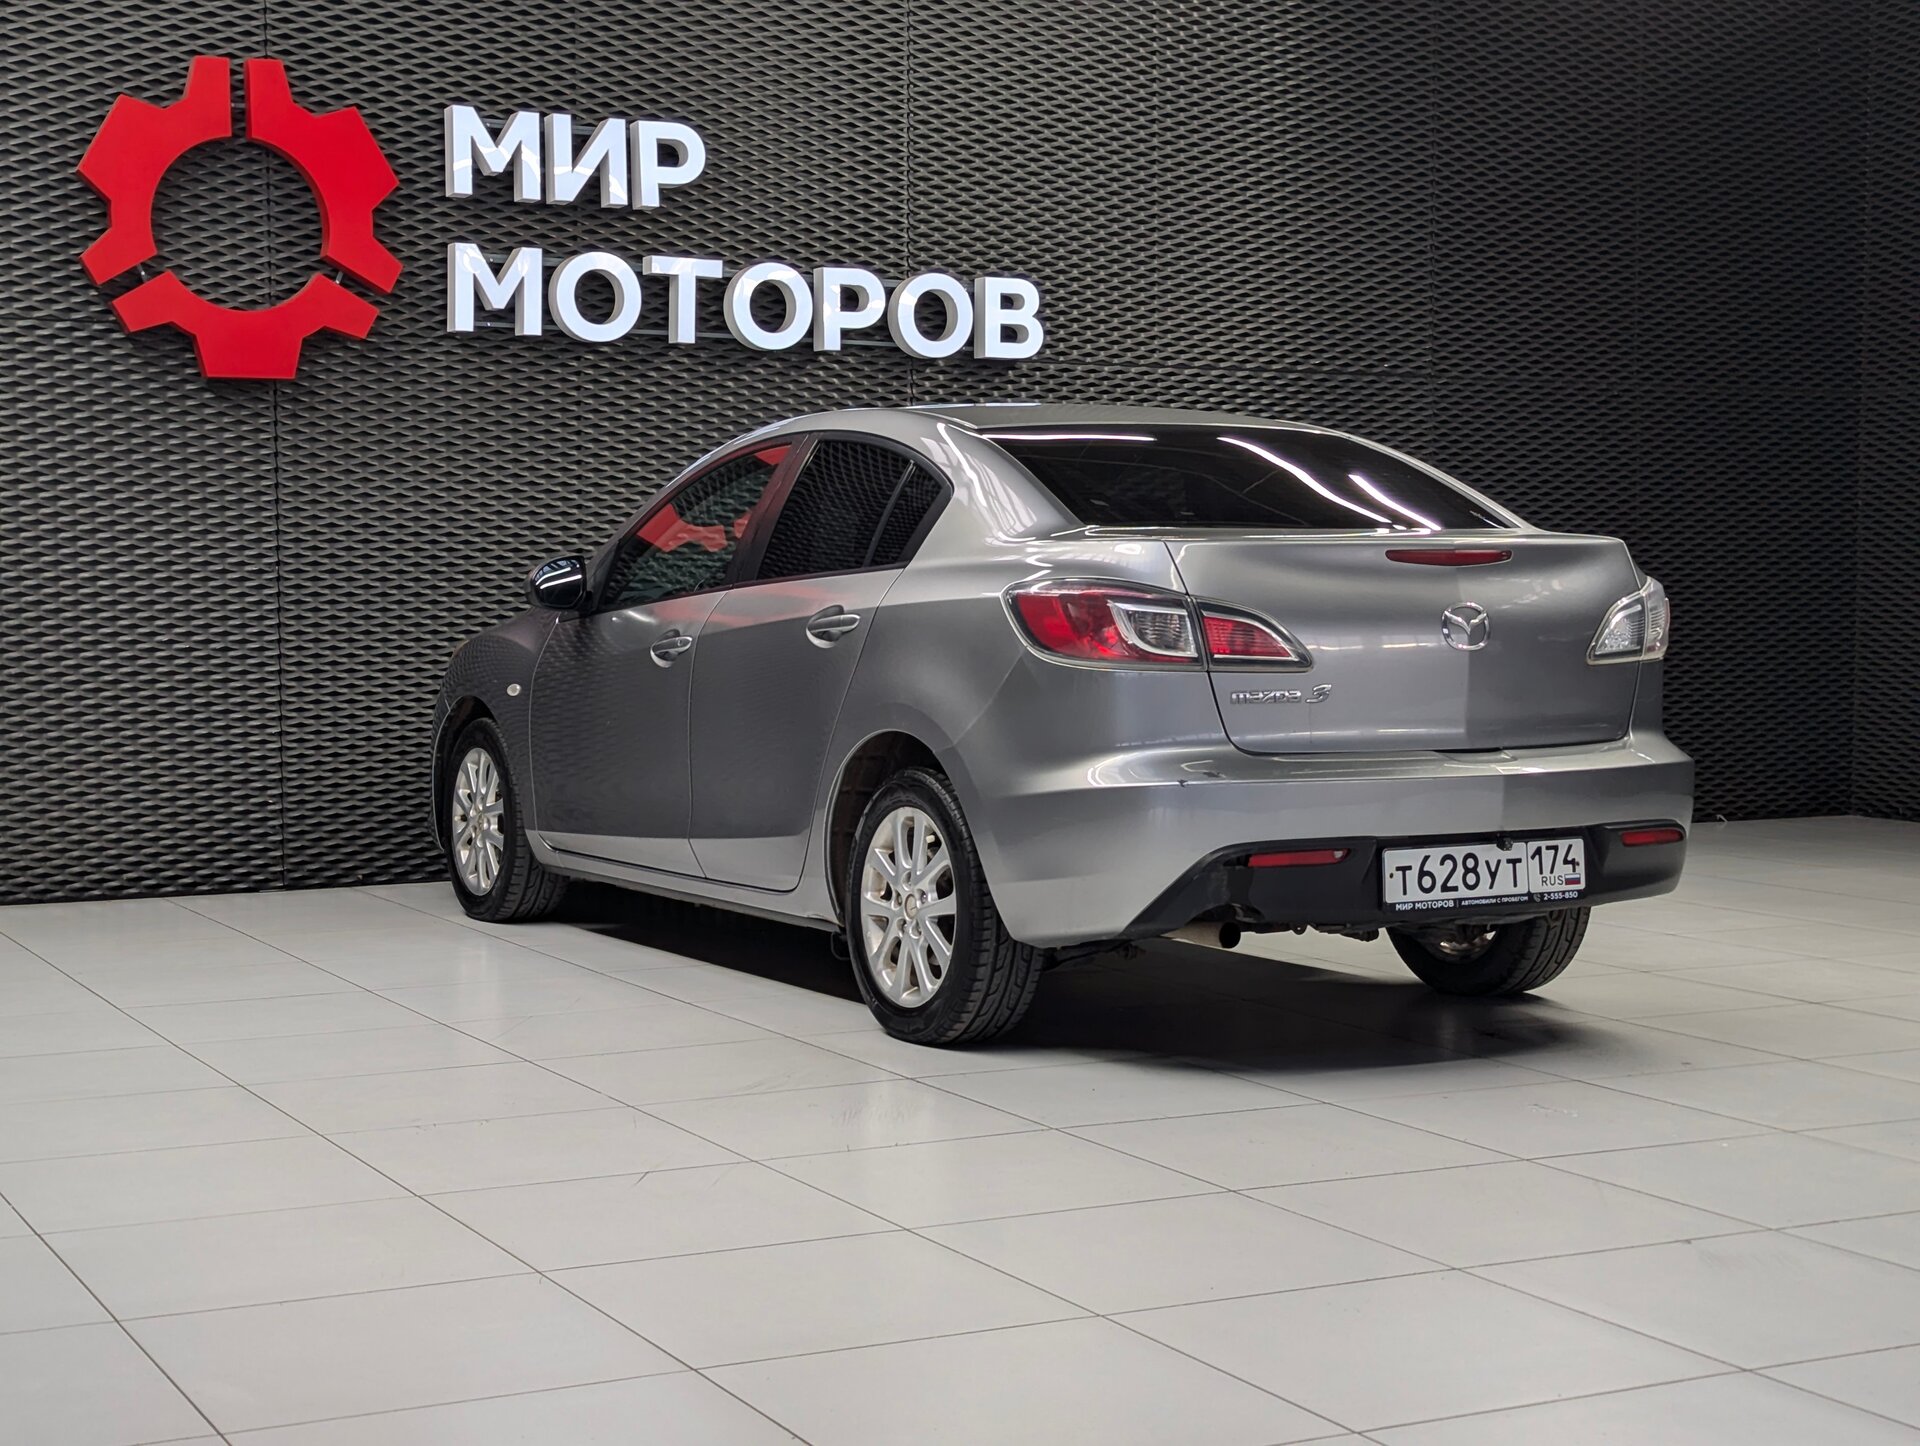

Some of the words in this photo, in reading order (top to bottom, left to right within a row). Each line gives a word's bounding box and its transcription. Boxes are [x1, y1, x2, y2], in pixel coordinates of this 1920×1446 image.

[444, 104, 706, 210] МИР
[447, 242, 1045, 359] МОТОРОВ
[1305, 683, 1332, 704] 3
[1395, 852, 1522, 896] Т628УТ
[1530, 843, 1578, 876] 174
[1541, 874, 1564, 887] RUS
[1395, 902, 1414, 911] МИР
[1415, 899, 1455, 911] МОТОРОВ
[1543, 890, 1578, 901] 2-555-850
